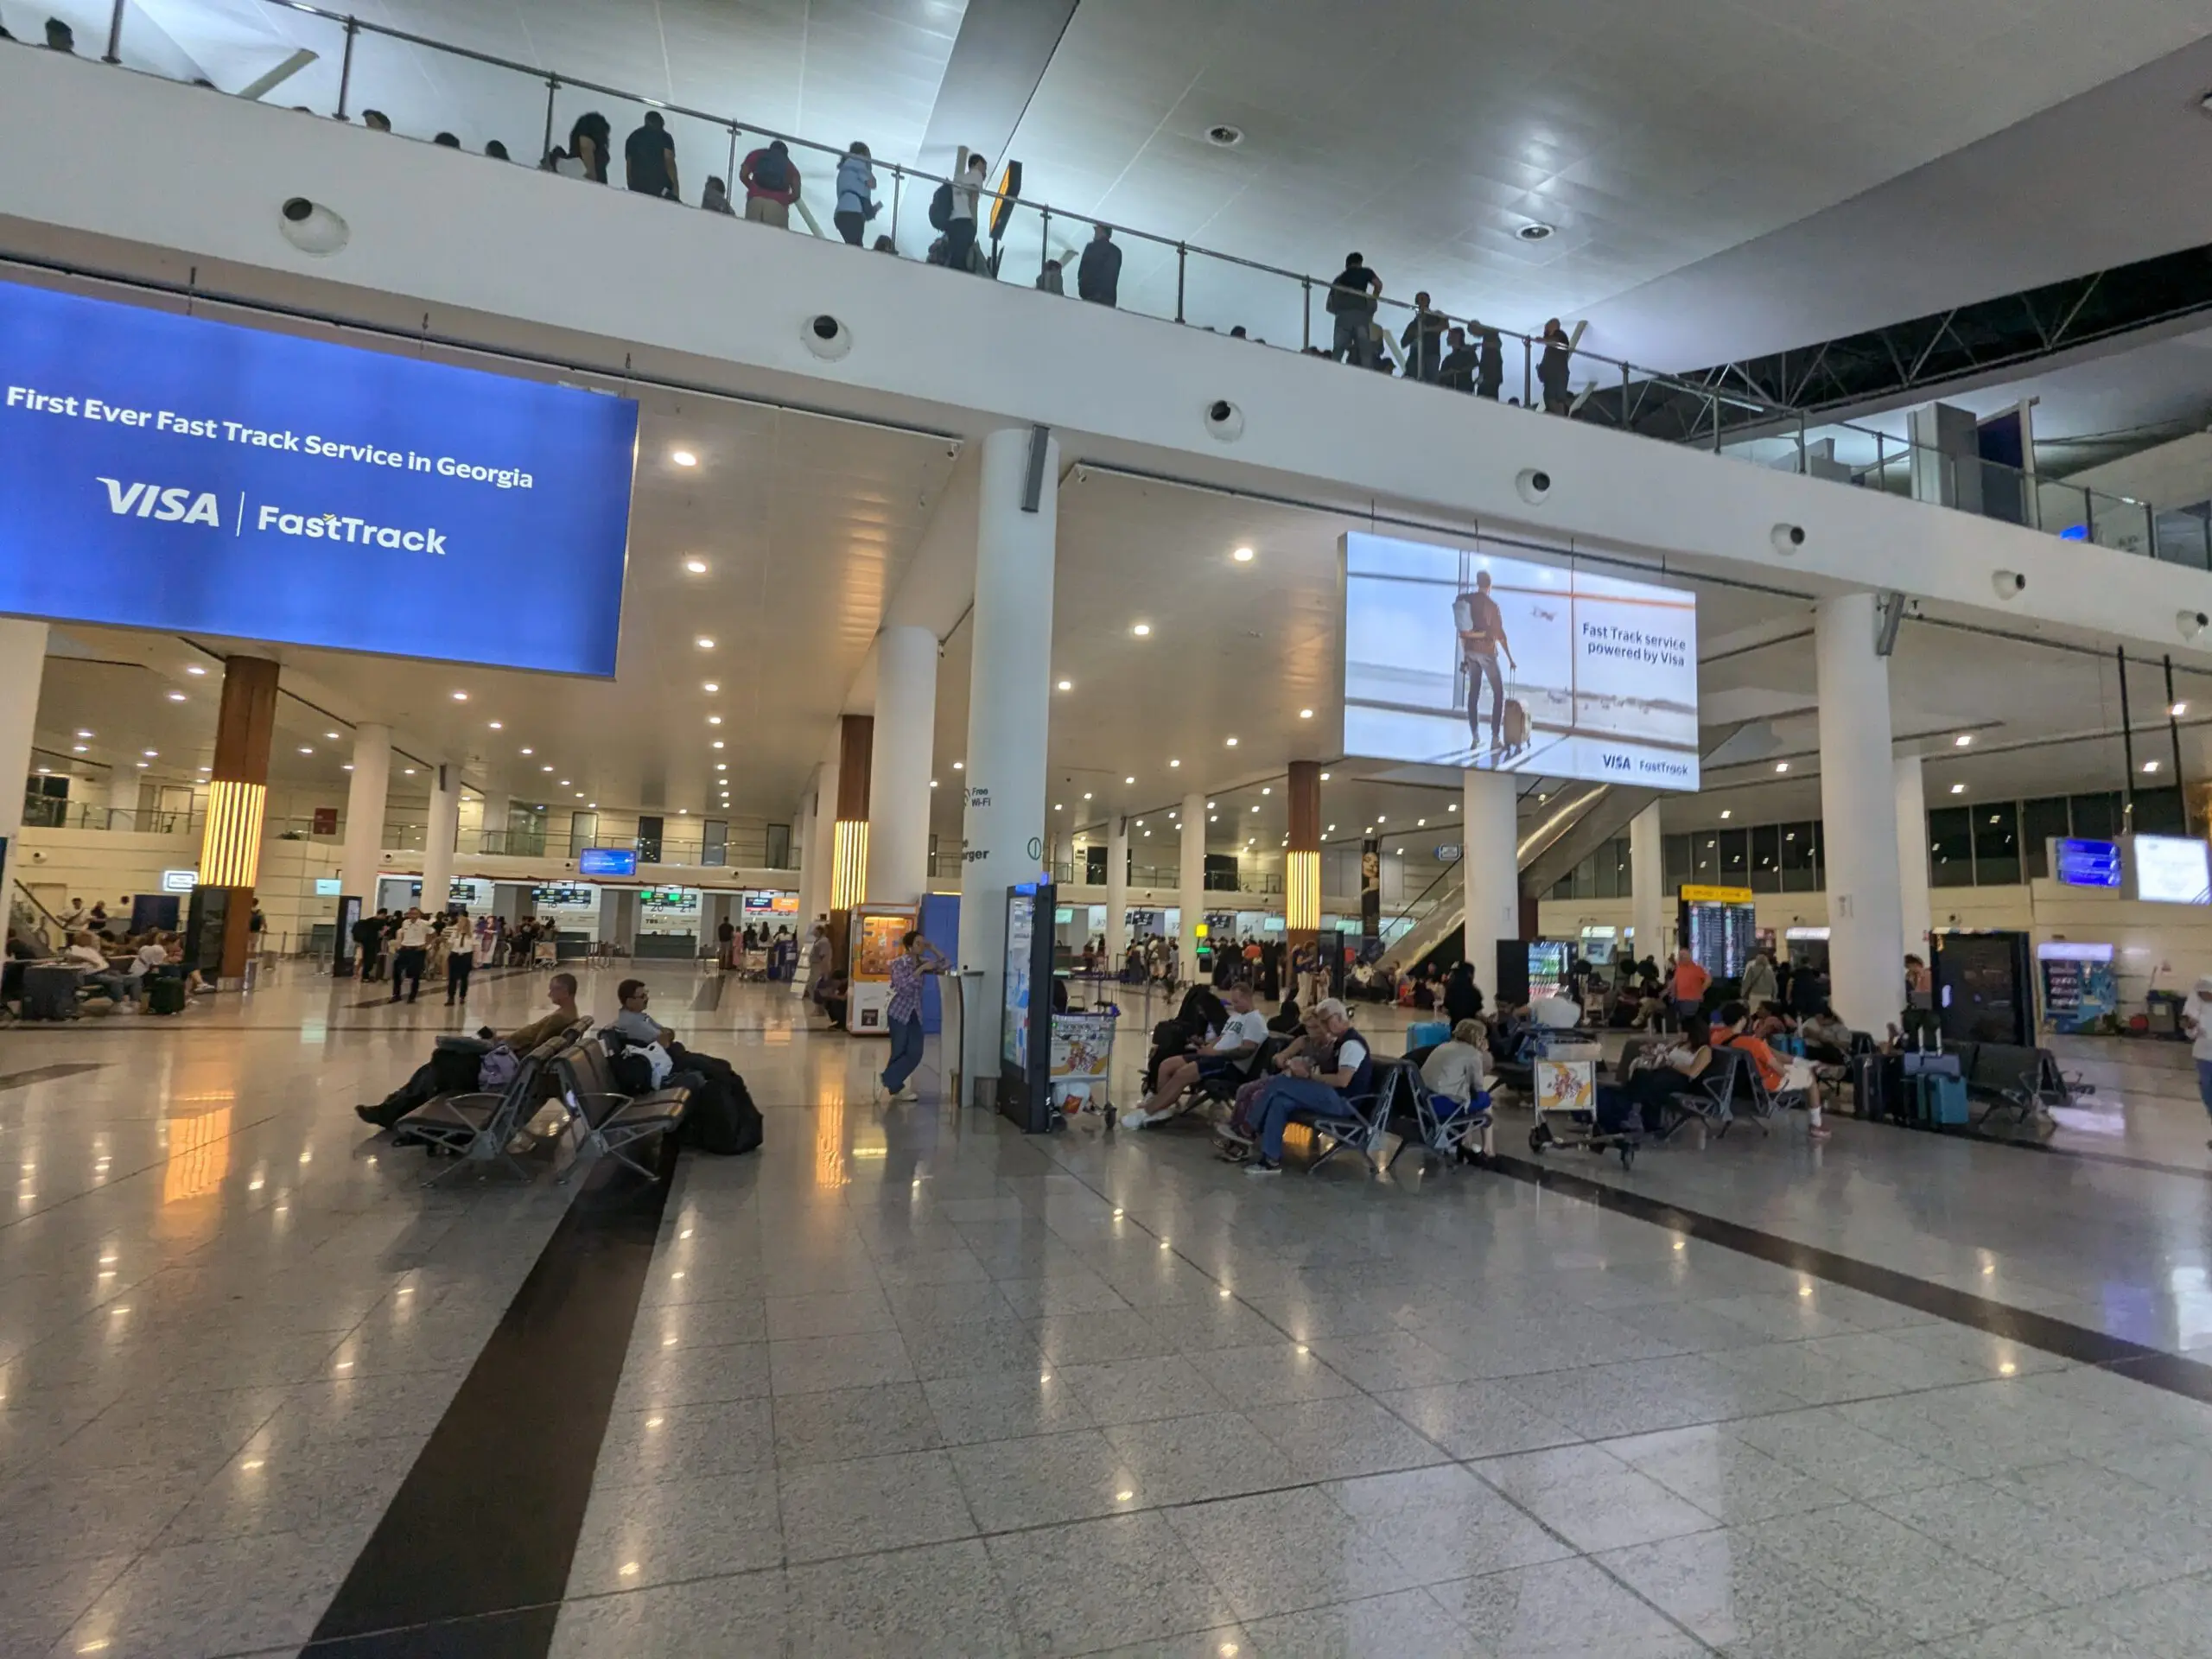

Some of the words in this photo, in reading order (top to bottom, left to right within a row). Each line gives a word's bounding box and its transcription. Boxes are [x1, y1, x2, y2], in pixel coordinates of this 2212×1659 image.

[7, 385, 79, 416] First
[84, 398, 151, 427] Ever
[156, 410, 217, 439] Fast
[223, 421, 299, 452] Track
[304, 435, 403, 467] Service
[407, 451, 431, 473] in
[436, 457, 533, 489] Georgia
[95, 476, 219, 528] VISA
[257, 505, 447, 555] FastTrack
[1582, 622, 1608, 639] Fast
[1611, 626, 1643, 644] Track
[1644, 634, 1686, 651] service
[1587, 642, 1641, 661] powered
[1643, 647, 1658, 664] by
[1661, 651, 1685, 667] Visa
[1603, 753, 1631, 771] VISA
[1639, 760, 1688, 776] FastTrack
[971, 787, 988, 796] Free
[971, 798, 991, 807] Wi-Fi
